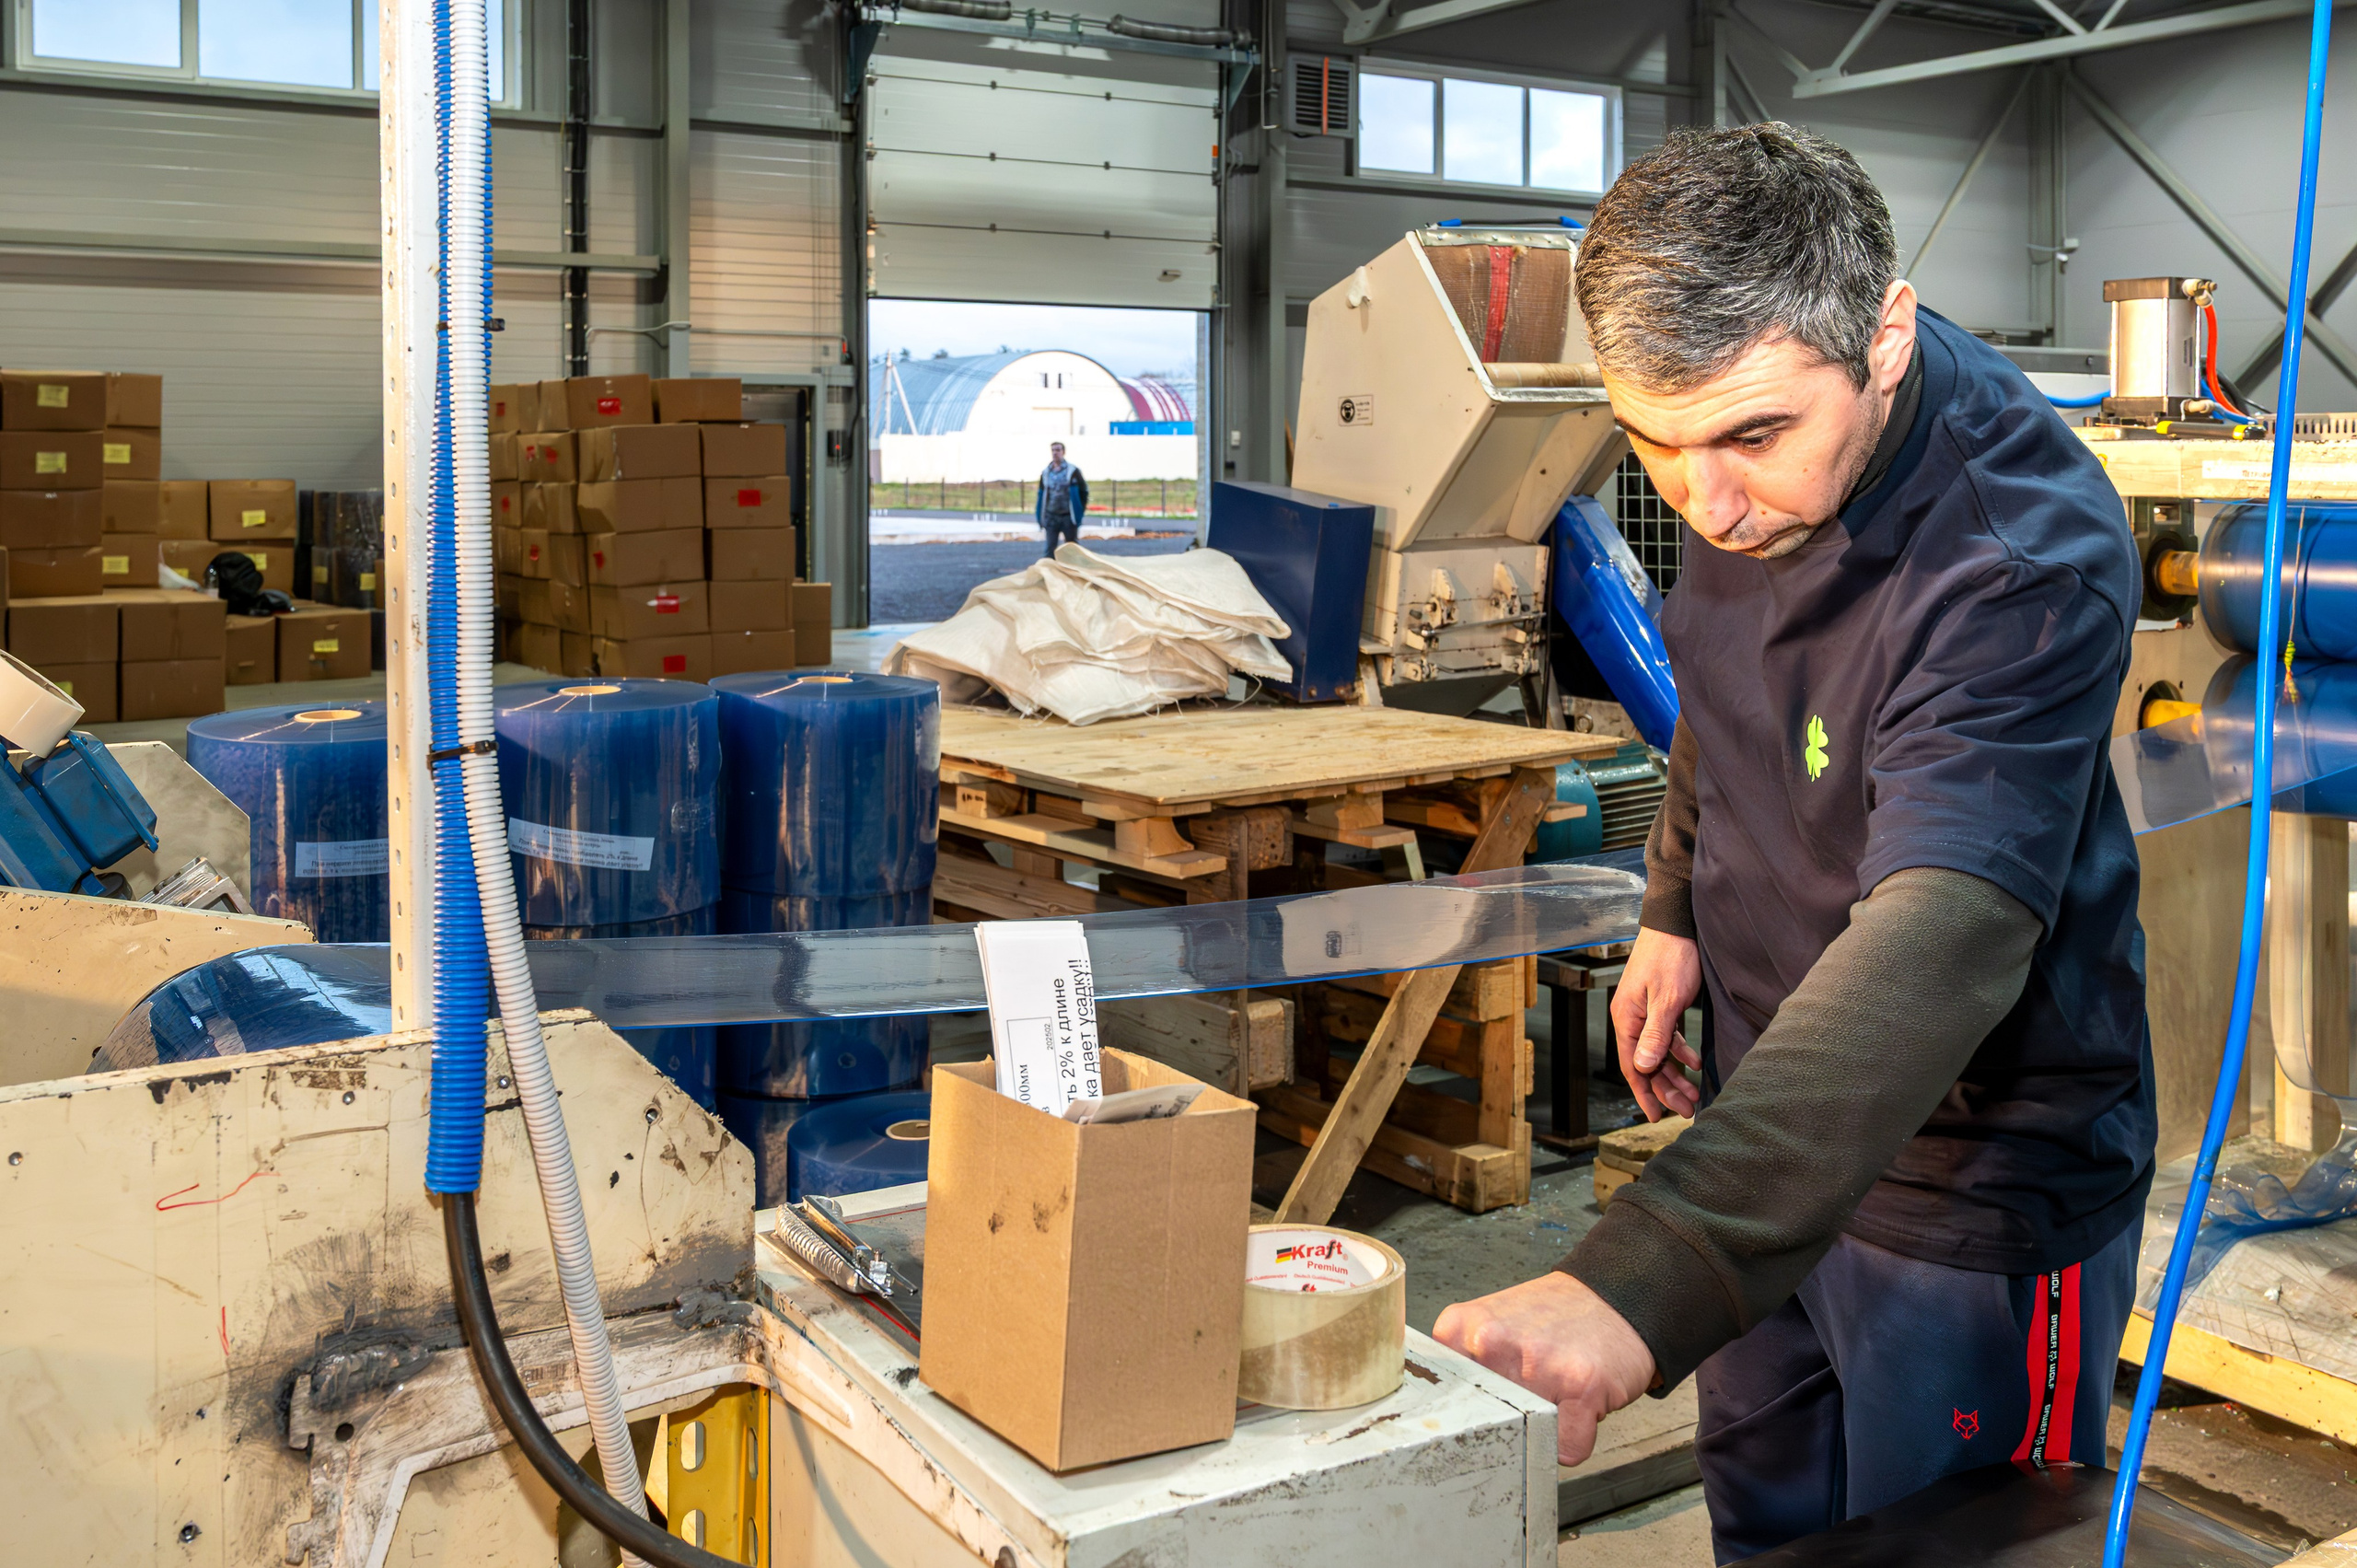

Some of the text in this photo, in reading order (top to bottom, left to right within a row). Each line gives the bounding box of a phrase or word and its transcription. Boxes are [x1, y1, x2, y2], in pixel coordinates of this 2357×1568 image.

[1054, 979, 1072, 1031] длине
[1068, 959, 1091, 1027] усадку!!
[1044, 1024, 1053, 1050] 202502
[1062, 1036, 1071, 1044] к
[1060, 1051, 1075, 1078] 2%
[1081, 1032, 1098, 1074] дает
[1291, 1239, 1342, 1260] Kraft
[1306, 1260, 1349, 1275] Premium
[2051, 1271, 2060, 1297] WOLF
